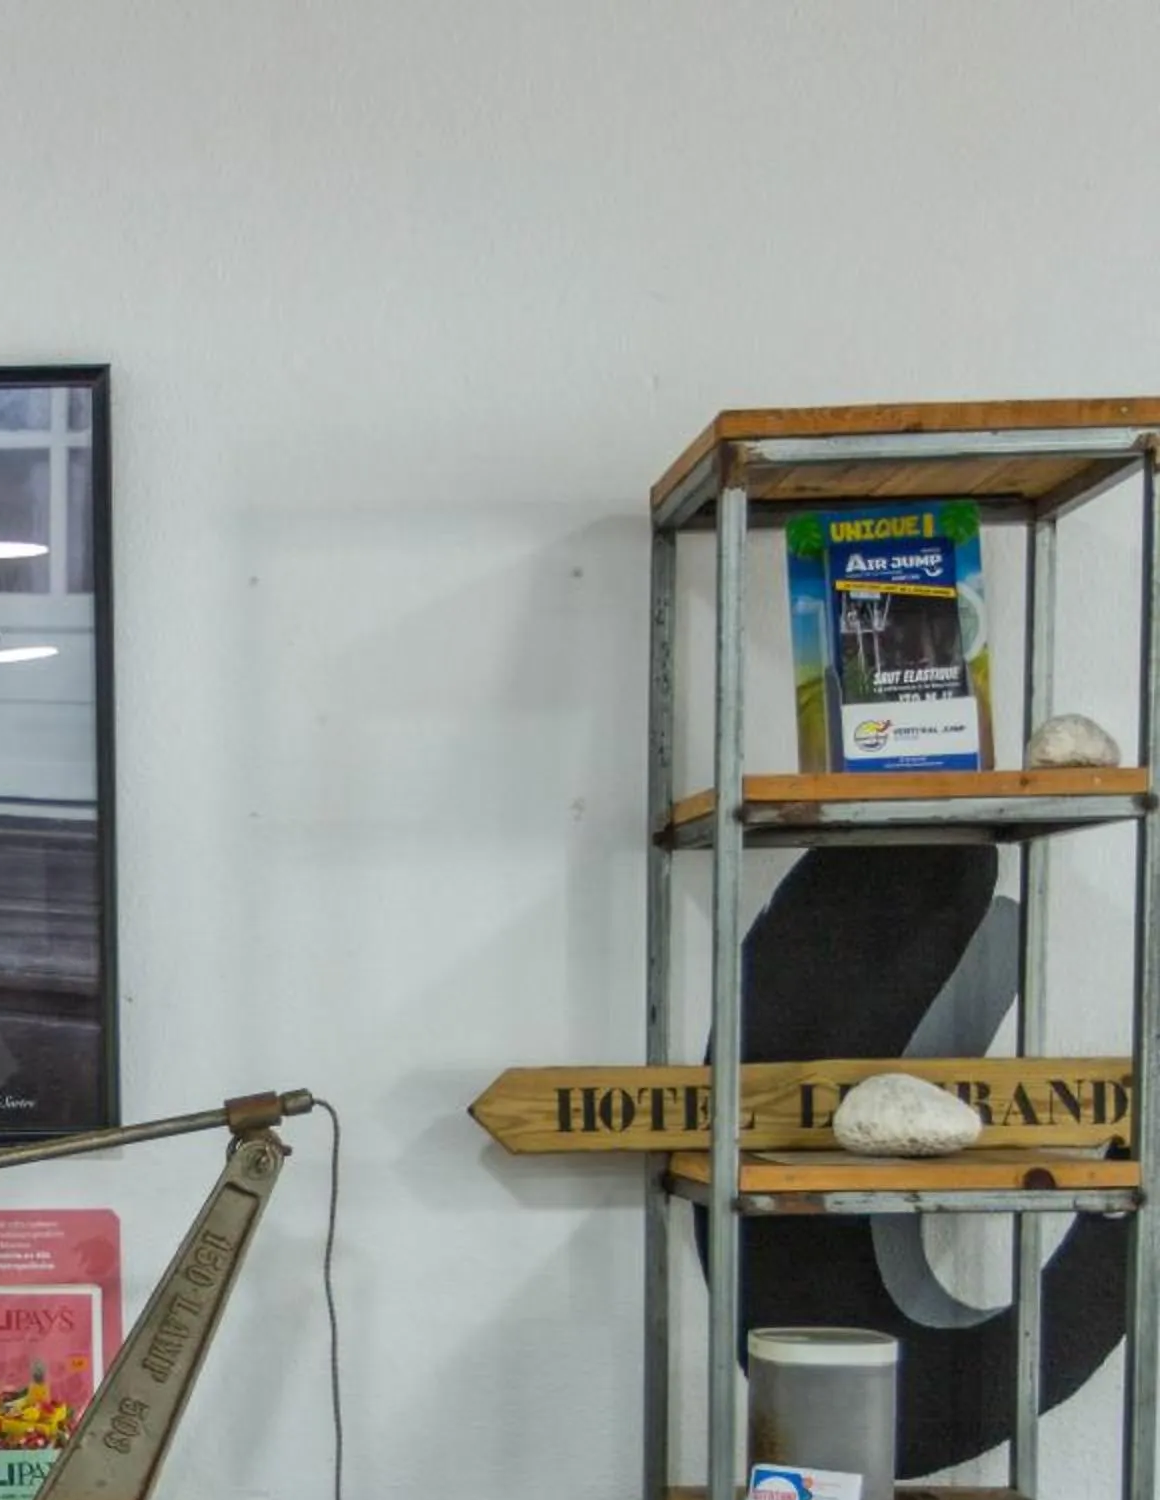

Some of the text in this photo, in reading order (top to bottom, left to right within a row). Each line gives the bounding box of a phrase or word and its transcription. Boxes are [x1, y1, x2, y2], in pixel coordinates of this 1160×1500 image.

[830, 515, 919, 542] UNIQUE
[891, 554, 944, 570] JUMP
[553, 1079, 1128, 1132] HOTE L RAND
[142, 1291, 199, 1384] LAMP
